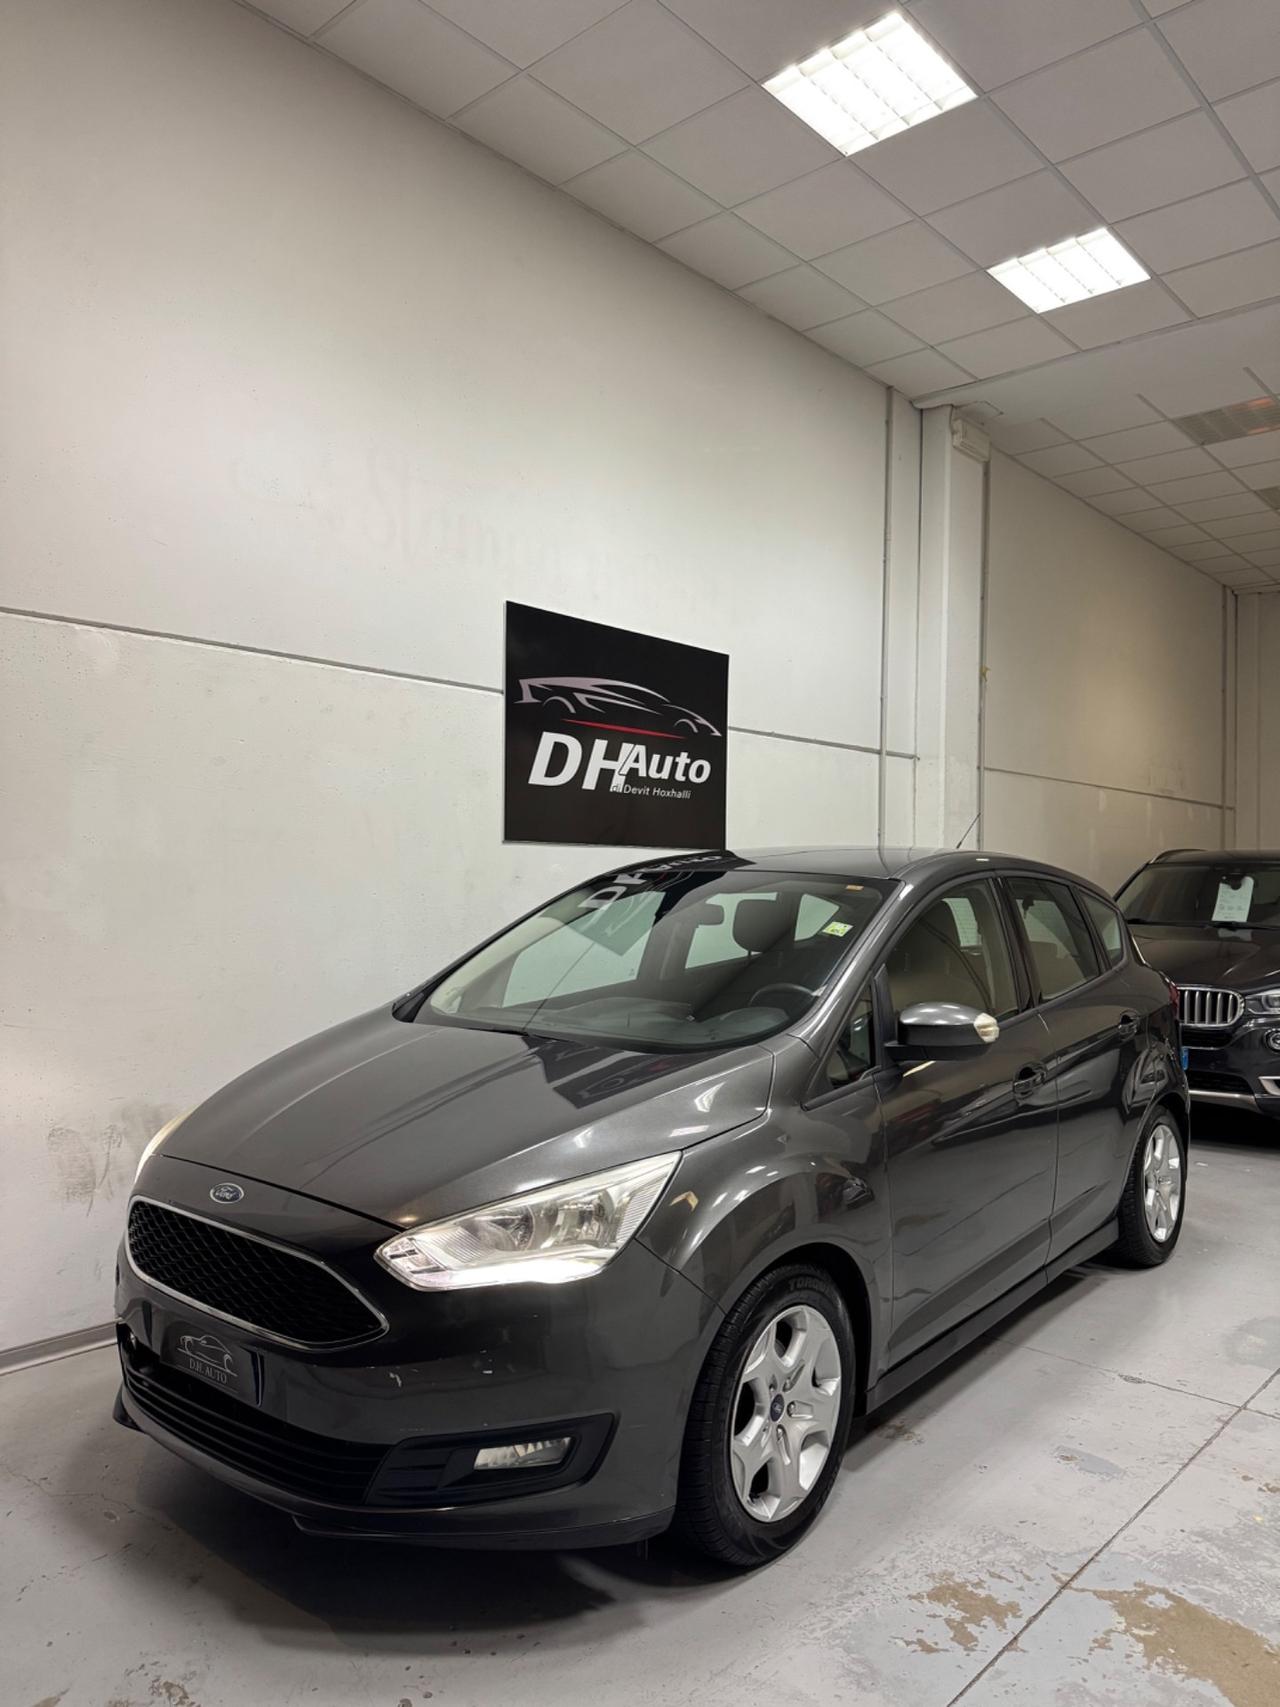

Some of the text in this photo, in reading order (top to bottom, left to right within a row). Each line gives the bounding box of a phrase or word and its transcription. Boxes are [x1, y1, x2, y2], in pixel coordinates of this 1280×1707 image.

[619, 744, 712, 783] Auto
[624, 784, 650, 796] Devit
[652, 787, 691, 799] Hoxhalli
[204, 1367, 227, 1384] AUTO
